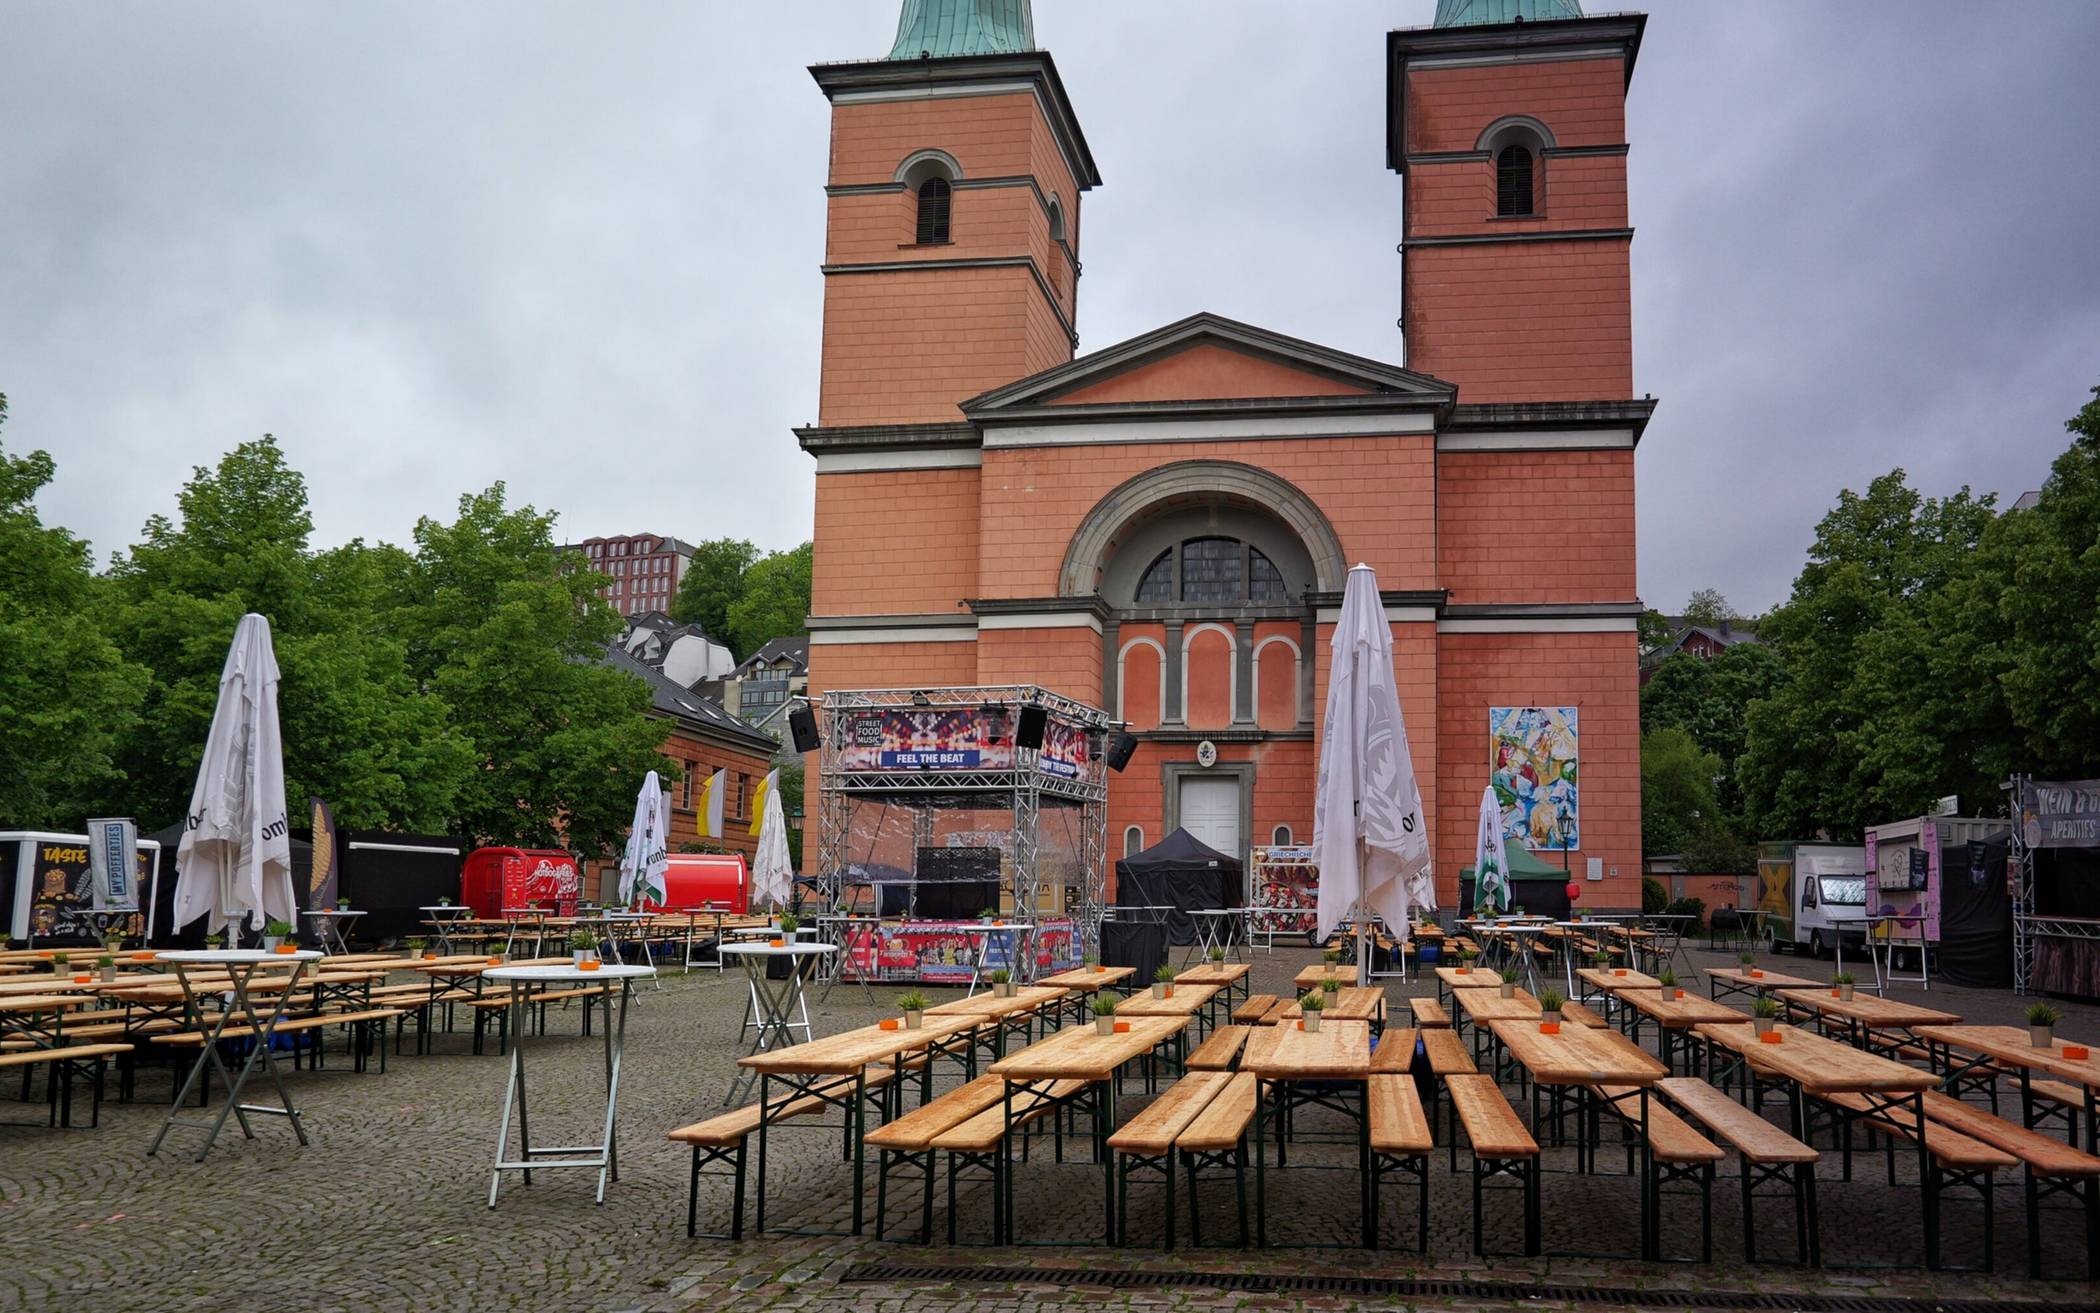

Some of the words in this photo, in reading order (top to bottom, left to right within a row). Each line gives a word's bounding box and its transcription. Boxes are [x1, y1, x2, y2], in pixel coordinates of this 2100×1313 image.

[858, 727, 880, 736] FOOD
[857, 736, 880, 744] MUSIC
[896, 753, 918, 763] FEEL
[920, 753, 939, 763] THE
[940, 753, 965, 763] BEAT
[2036, 788, 2073, 815] WEIN
[43, 847, 88, 863] TASTE
[111, 881, 123, 893] MY
